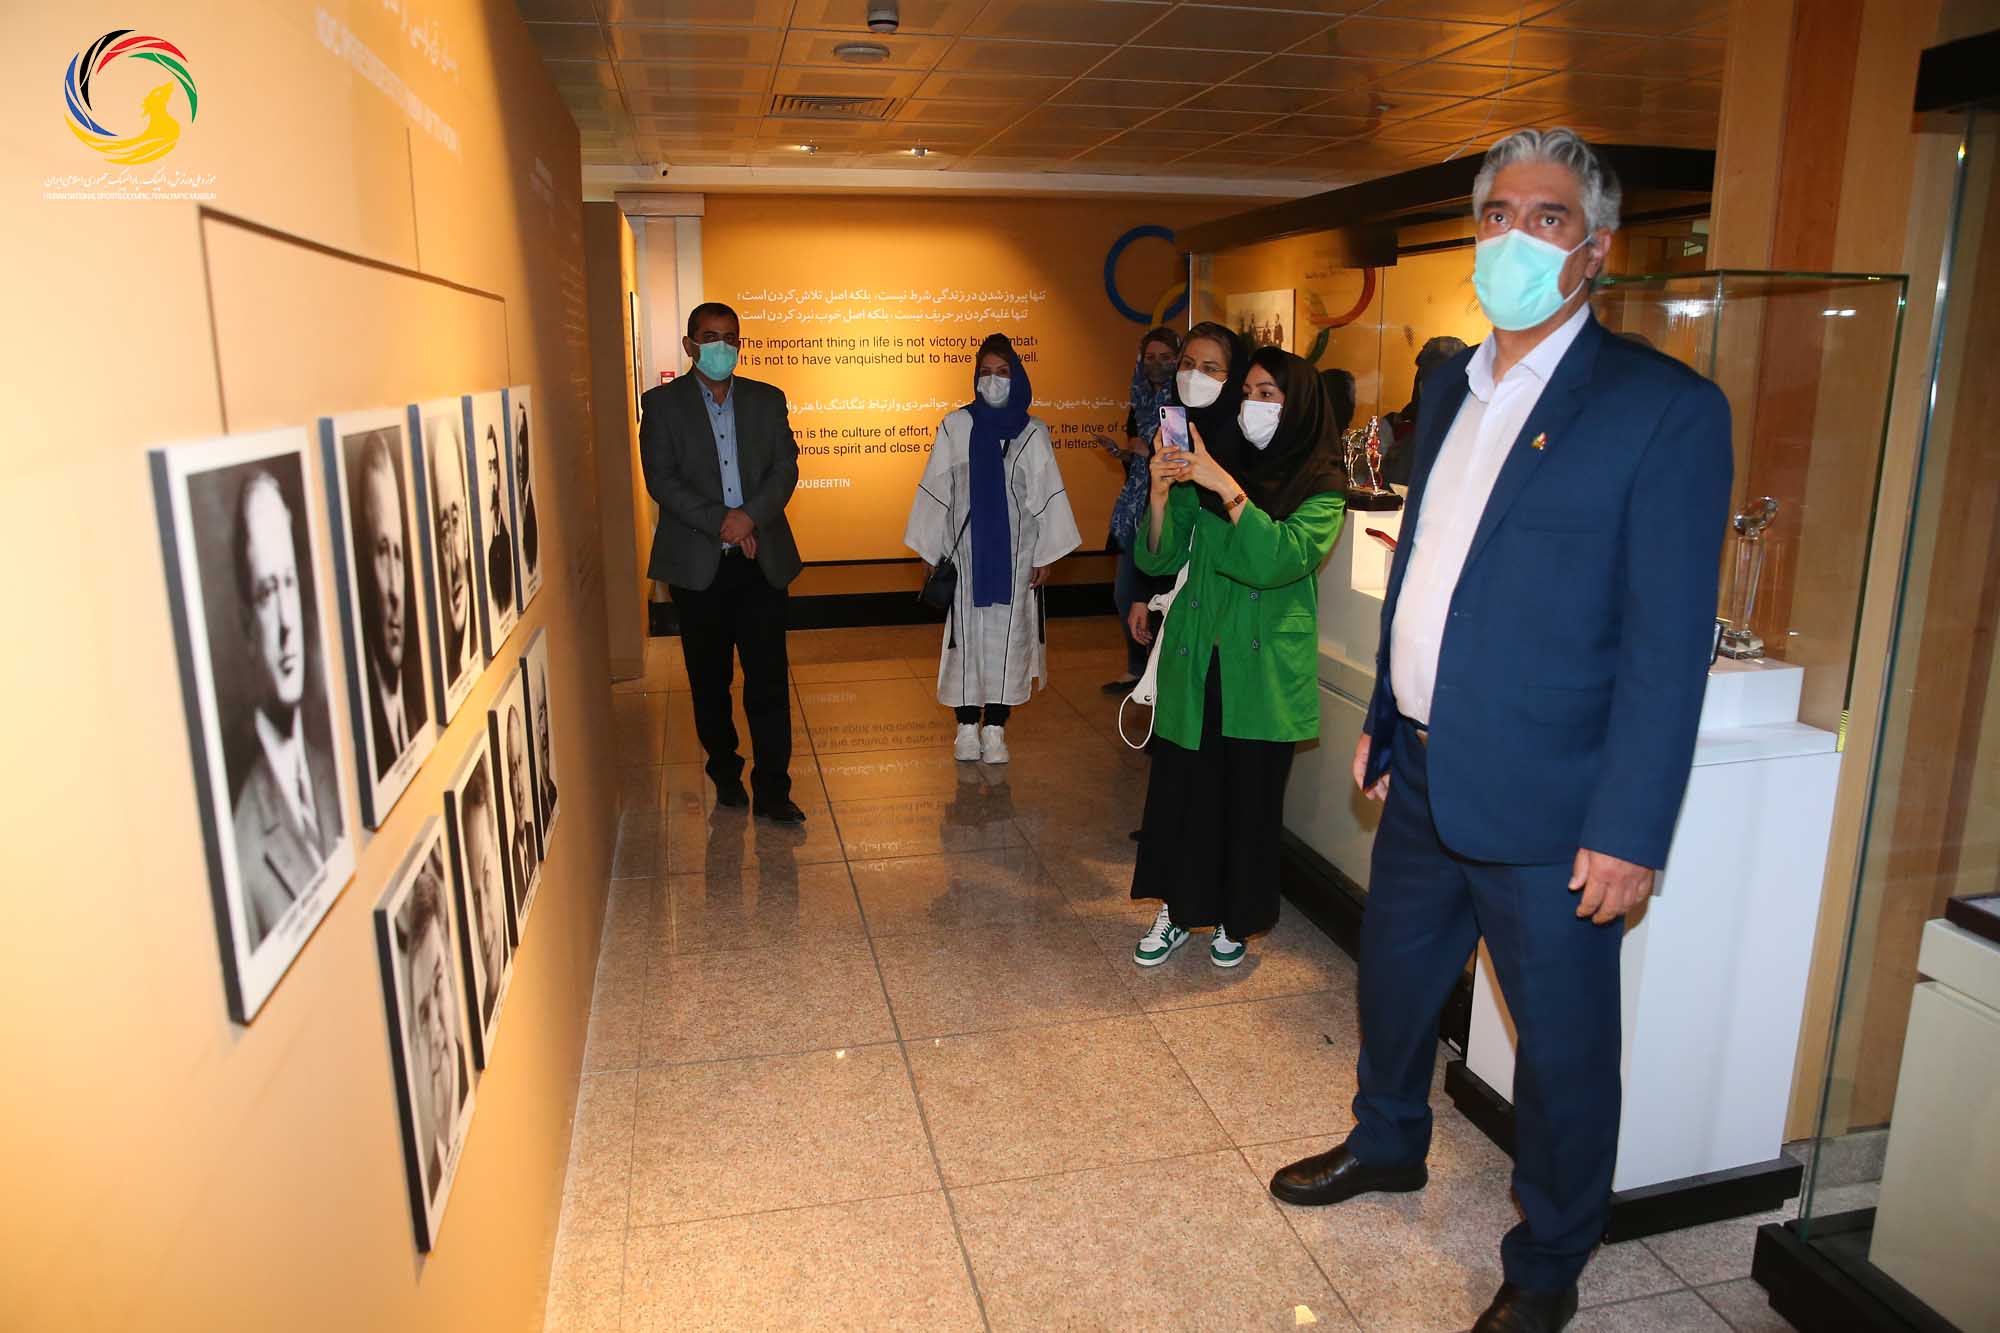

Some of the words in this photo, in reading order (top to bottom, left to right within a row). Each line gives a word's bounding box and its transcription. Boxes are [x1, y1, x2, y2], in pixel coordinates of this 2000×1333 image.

[767, 288, 797, 304] کردن
[795, 287, 823, 305] تلاش
[826, 287, 848, 305] اصل
[850, 287, 872, 304] بلکه
[910, 288, 934, 305] شرط
[932, 287, 966, 304] زندگی
[966, 291, 977, 303] در
[979, 288, 1004, 302] شدن
[1004, 289, 1029, 304] پیروز
[1030, 287, 1047, 302] تنها
[767, 307, 797, 323] کردن
[797, 308, 814, 323] نبرد
[816, 309, 842, 323] خوب
[842, 307, 865, 323] اصل
[867, 307, 889, 323] بلکه
[925, 309, 954, 322] حریف
[953, 311, 964, 322] بر
[964, 306, 992, 322] کردن
[991, 308, 1010, 323] غلبه
[1011, 307, 1029, 322] تنها
[740, 337, 763, 348] The
[767, 336, 823, 350] important
[827, 336, 856, 350] thing
[859, 336, 870, 347] in
[874, 335, 890, 347] life
[894, 335, 904, 347] is
[906, 335, 925, 347] not
[930, 335, 966, 350] victory
[970, 335, 984, 347] bu
[740, 353, 748, 366] It
[751, 354, 761, 366] is
[764, 354, 783, 366] not
[787, 354, 799, 366] to
[803, 353, 831, 365] have
[834, 353, 903, 367] vanquished
[906, 352, 925, 364] but
[929, 353, 940, 364] to
[944, 352, 972, 364] have
[797, 400, 815, 416] هنر
[814, 399, 824, 414] با
[823, 395, 867, 411] تنگاتنگ
[868, 398, 896, 412] ارتباط
[903, 396, 949, 412] جوانمردی
[806, 427, 817, 440] is
[820, 426, 838, 440] the
[841, 425, 881, 439] culture
[884, 425, 896, 438] of
[899, 424, 932, 439] effort,
[1061, 423, 1079, 434] the
[1081, 423, 1105, 433] love
[1107, 422, 1119, 433] of
[833, 442, 862, 457] spirit
[864, 442, 887, 455] and
[889, 441, 921, 454] close
[1051, 438, 1062, 449] nd
[796, 478, 851, 489] OUBERTIN
